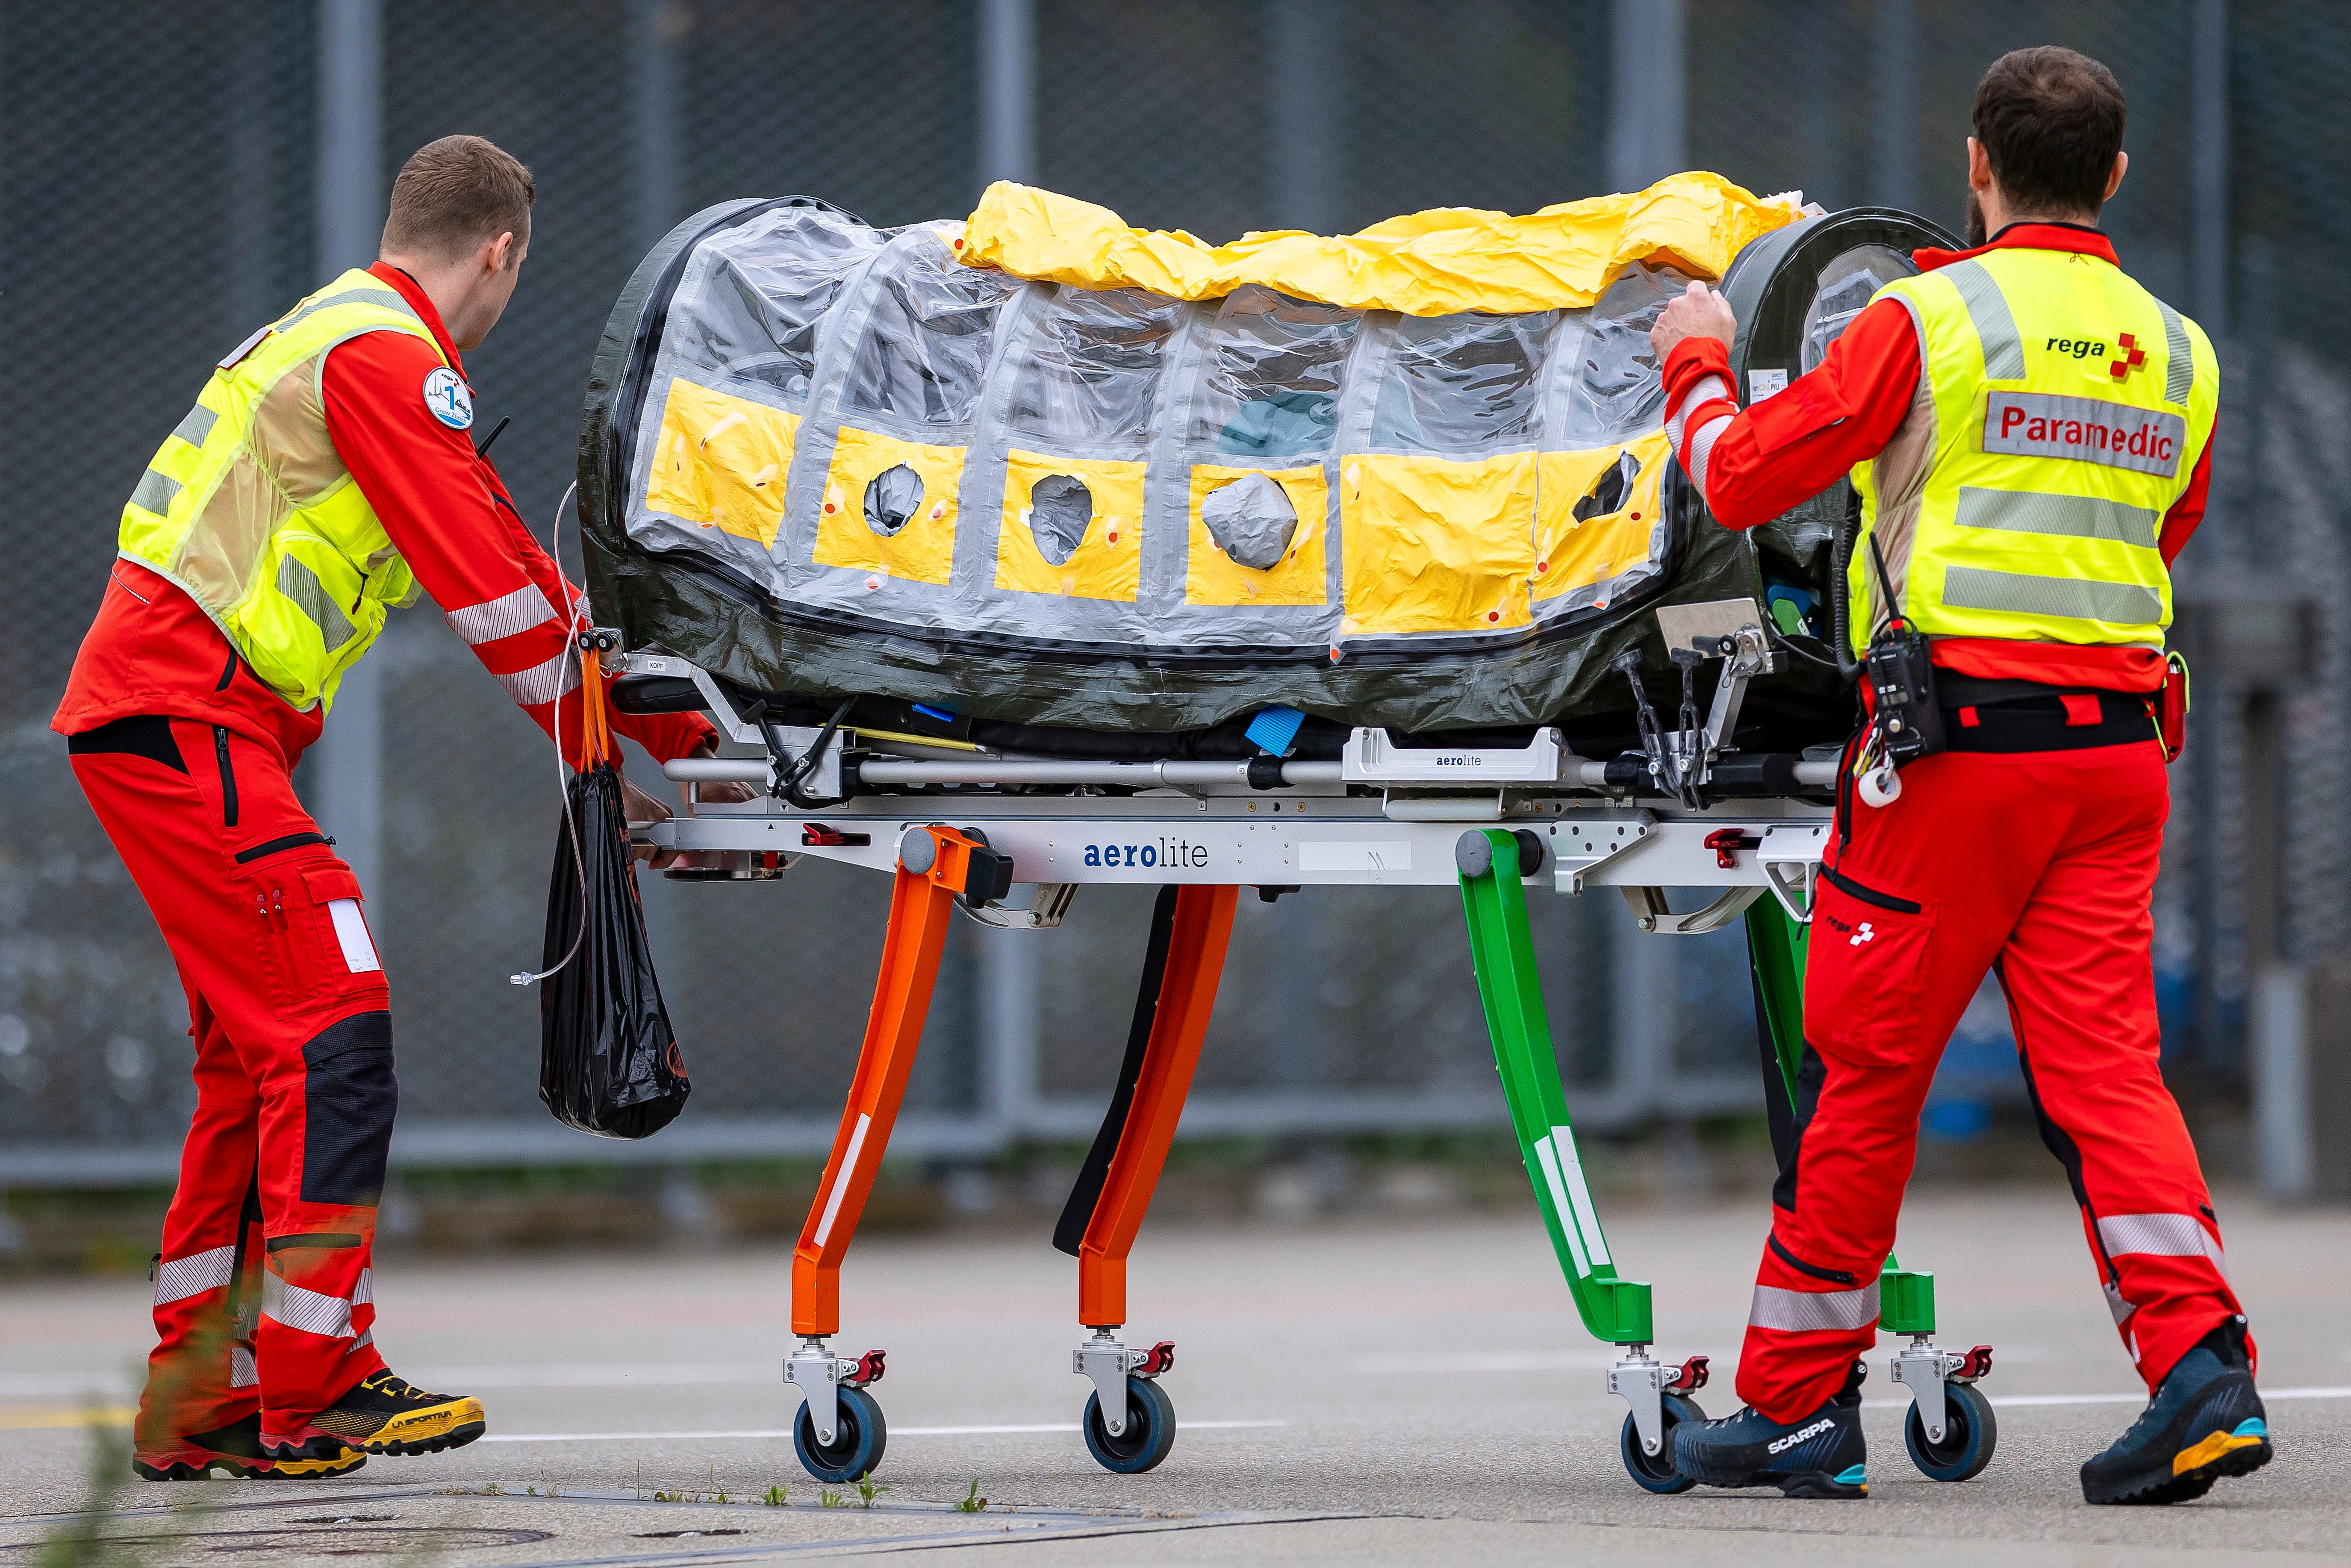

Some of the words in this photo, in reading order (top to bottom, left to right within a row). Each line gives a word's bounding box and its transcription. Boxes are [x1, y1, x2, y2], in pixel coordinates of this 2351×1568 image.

[2046, 338, 2105, 359] rega
[441, 373, 453, 381] rega
[445, 386, 454, 410] 1
[435, 407, 450, 416] Crew
[451, 412, 467, 424] Zürich
[2001, 405, 2173, 461] Paramedic
[1437, 754, 1481, 766] aerolite
[1084, 837, 1208, 868] aerolite
[1826, 916, 1851, 933] rega
[392, 1421, 404, 1429] LA
[405, 1411, 452, 1426] SPORTIVA
[1768, 1418, 1835, 1454] SCARPA
